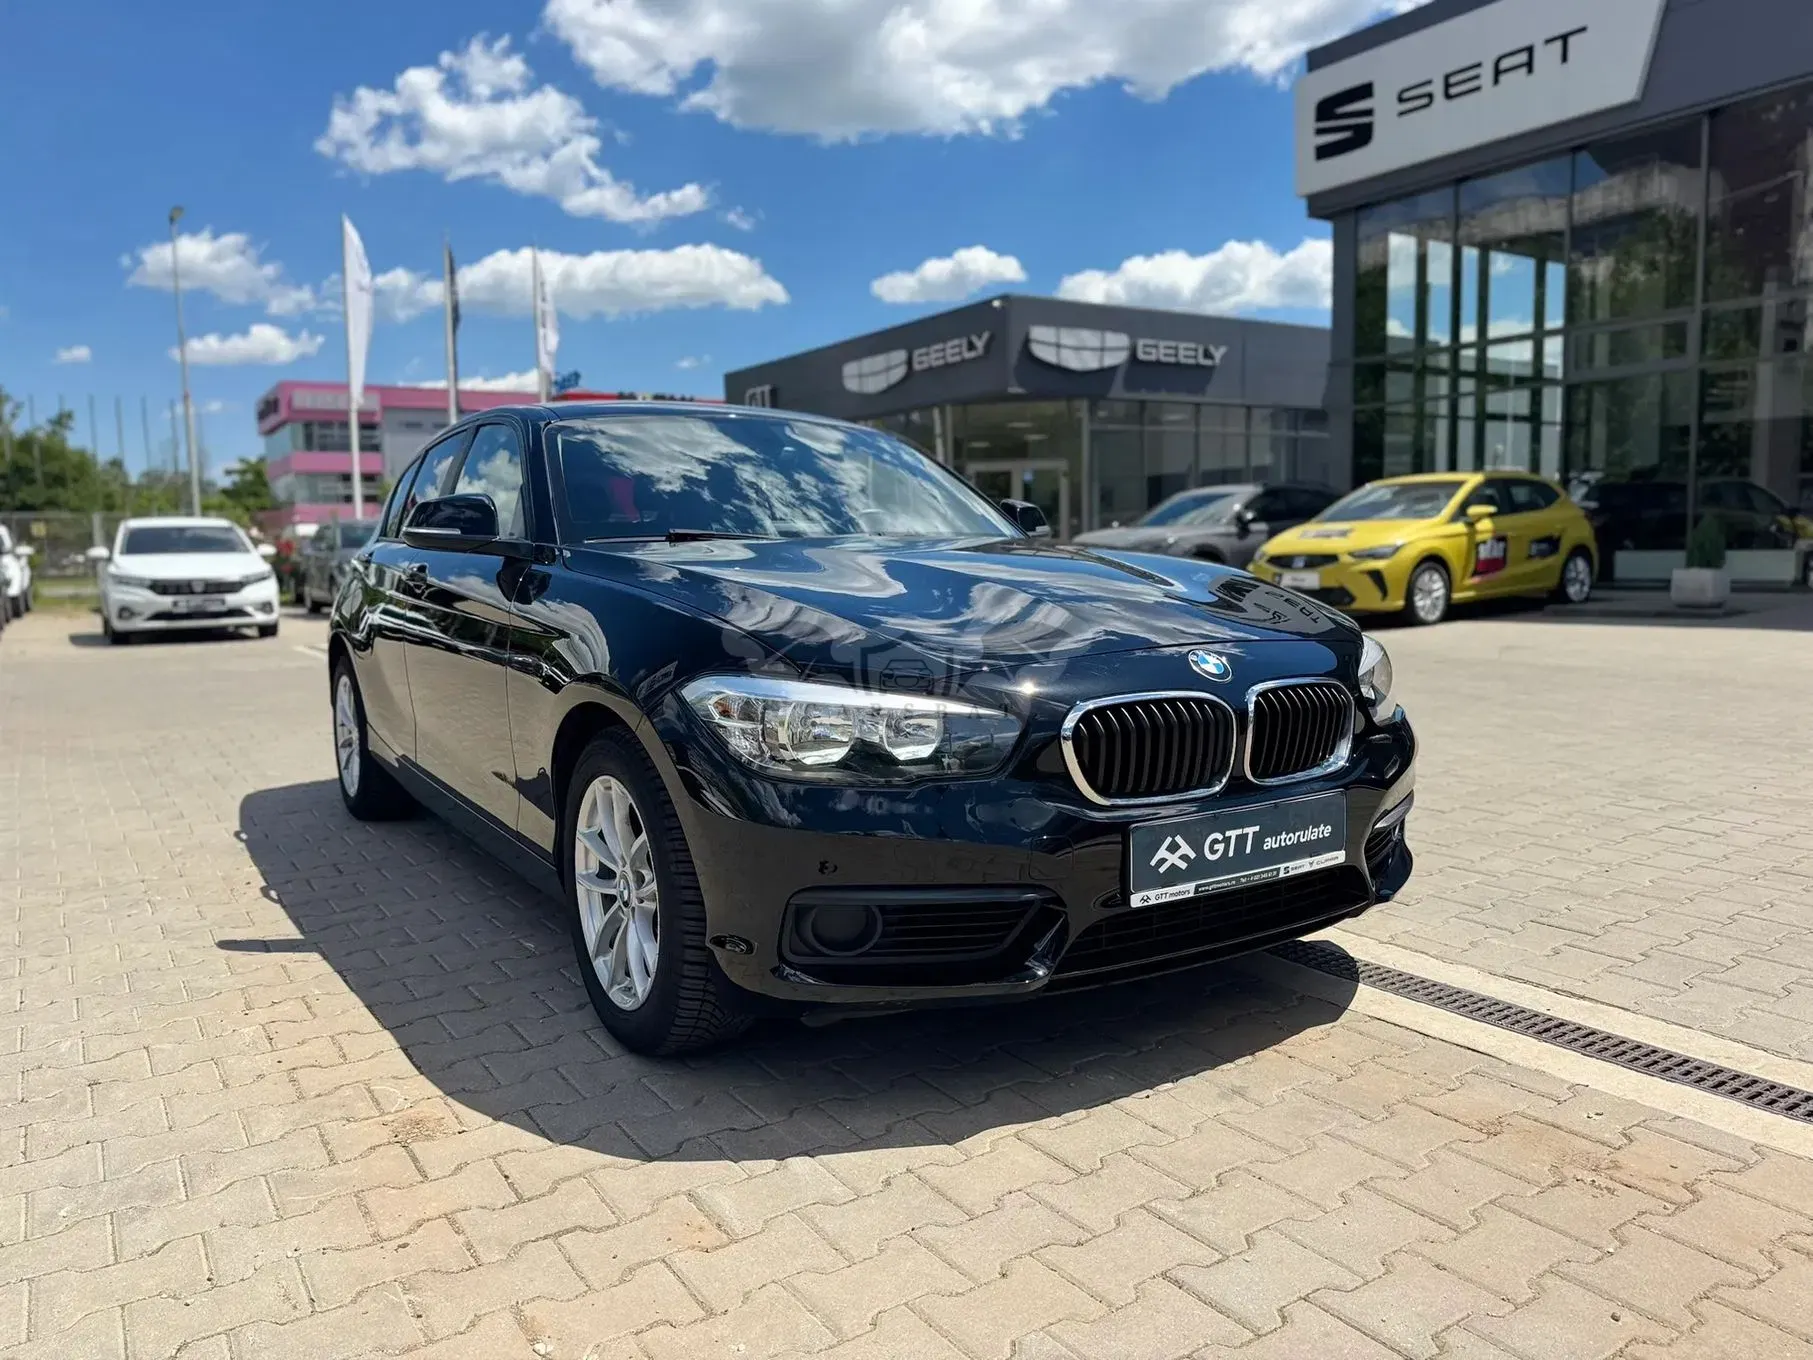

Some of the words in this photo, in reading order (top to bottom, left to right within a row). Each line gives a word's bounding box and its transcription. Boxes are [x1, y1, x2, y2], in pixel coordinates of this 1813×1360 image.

[1397, 25, 1588, 118] SEAT
[912, 331, 991, 372] GEELY
[1135, 338, 1228, 367] GEELY
[1203, 825, 1260, 861] GTT
[1263, 823, 1332, 850] autorulate
[1154, 892, 1169, 901] GTT
[1169, 889, 1190, 898] motors
